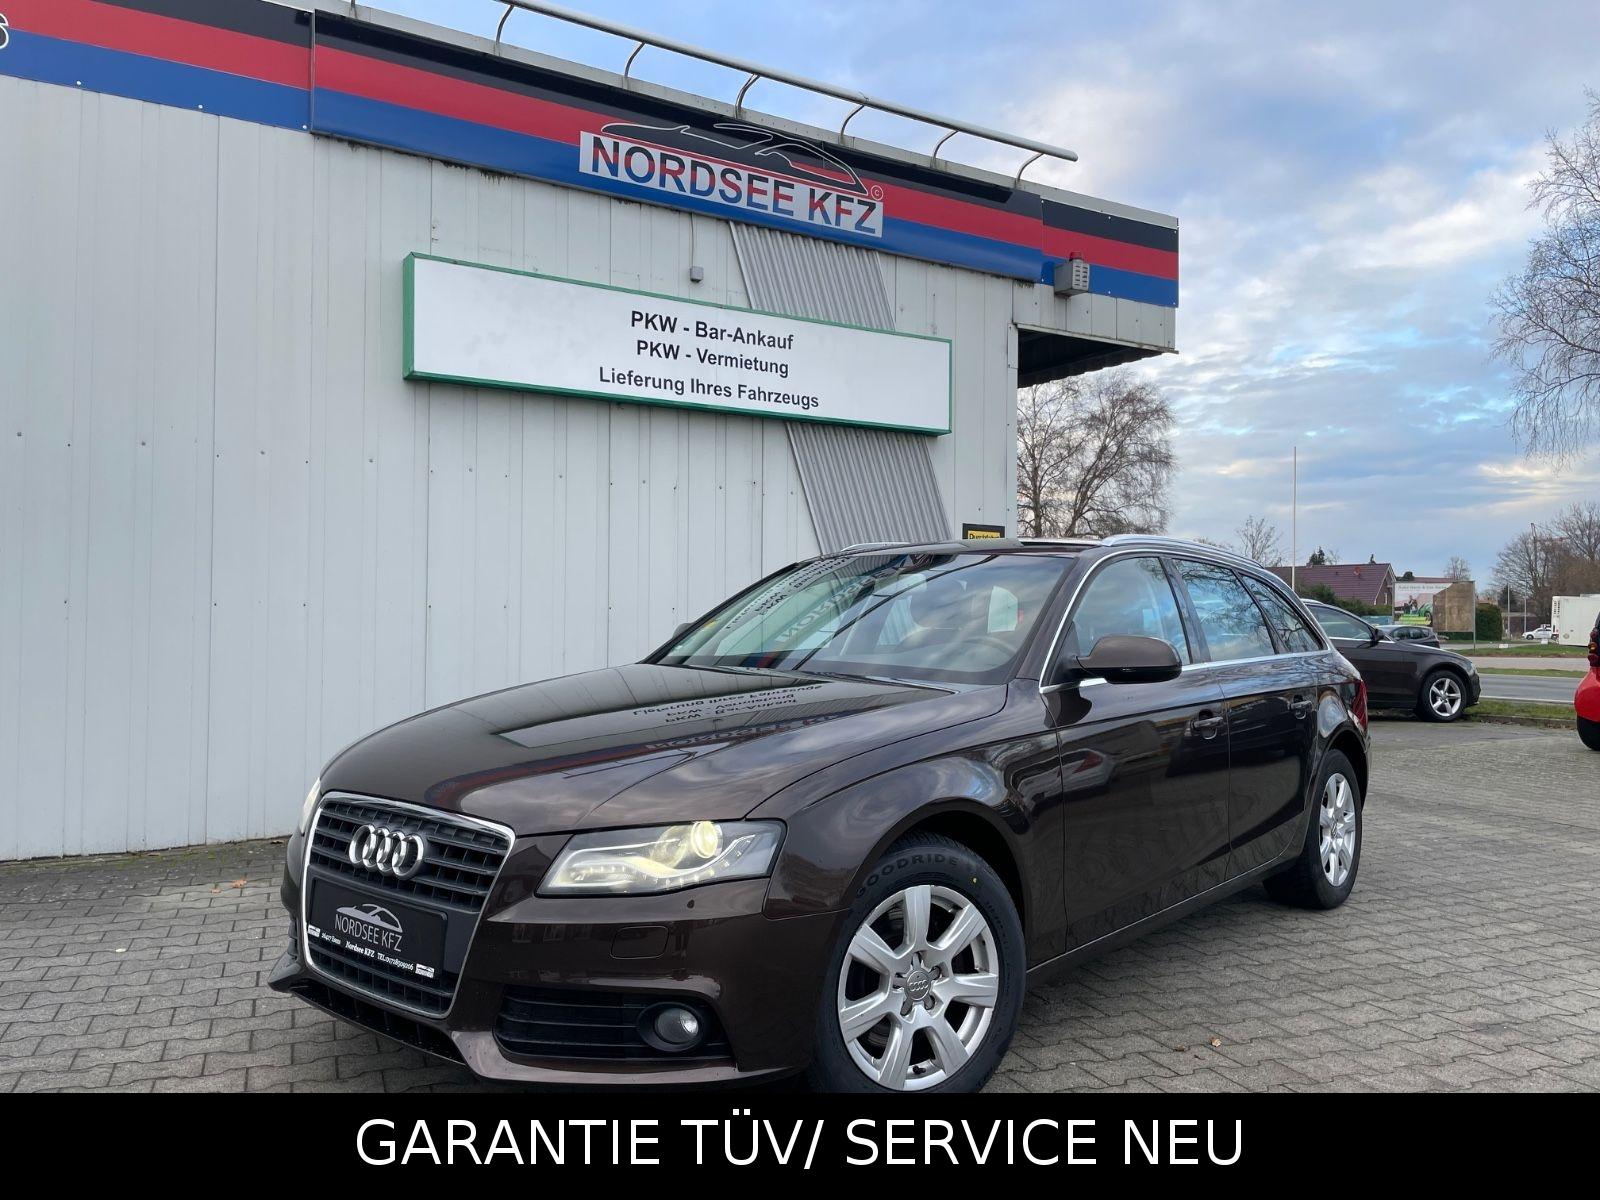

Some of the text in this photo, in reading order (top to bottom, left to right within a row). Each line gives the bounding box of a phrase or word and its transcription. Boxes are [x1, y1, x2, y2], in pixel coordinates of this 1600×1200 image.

[591, 136, 795, 217] NORDSEE
[808, 187, 877, 235] KFZ
[631, 310, 678, 334] PKW
[695, 320, 794, 350] Bar-Ankauf
[636, 339, 680, 361] PKW
[696, 347, 789, 379] Vermietung
[599, 366, 819, 410] Lieferung Ihres Fahrzeugs
[856, 853, 960, 898] GOODRIDE
[334, 913, 380, 945] NORDSEE
[381, 930, 403, 952] KFZ
